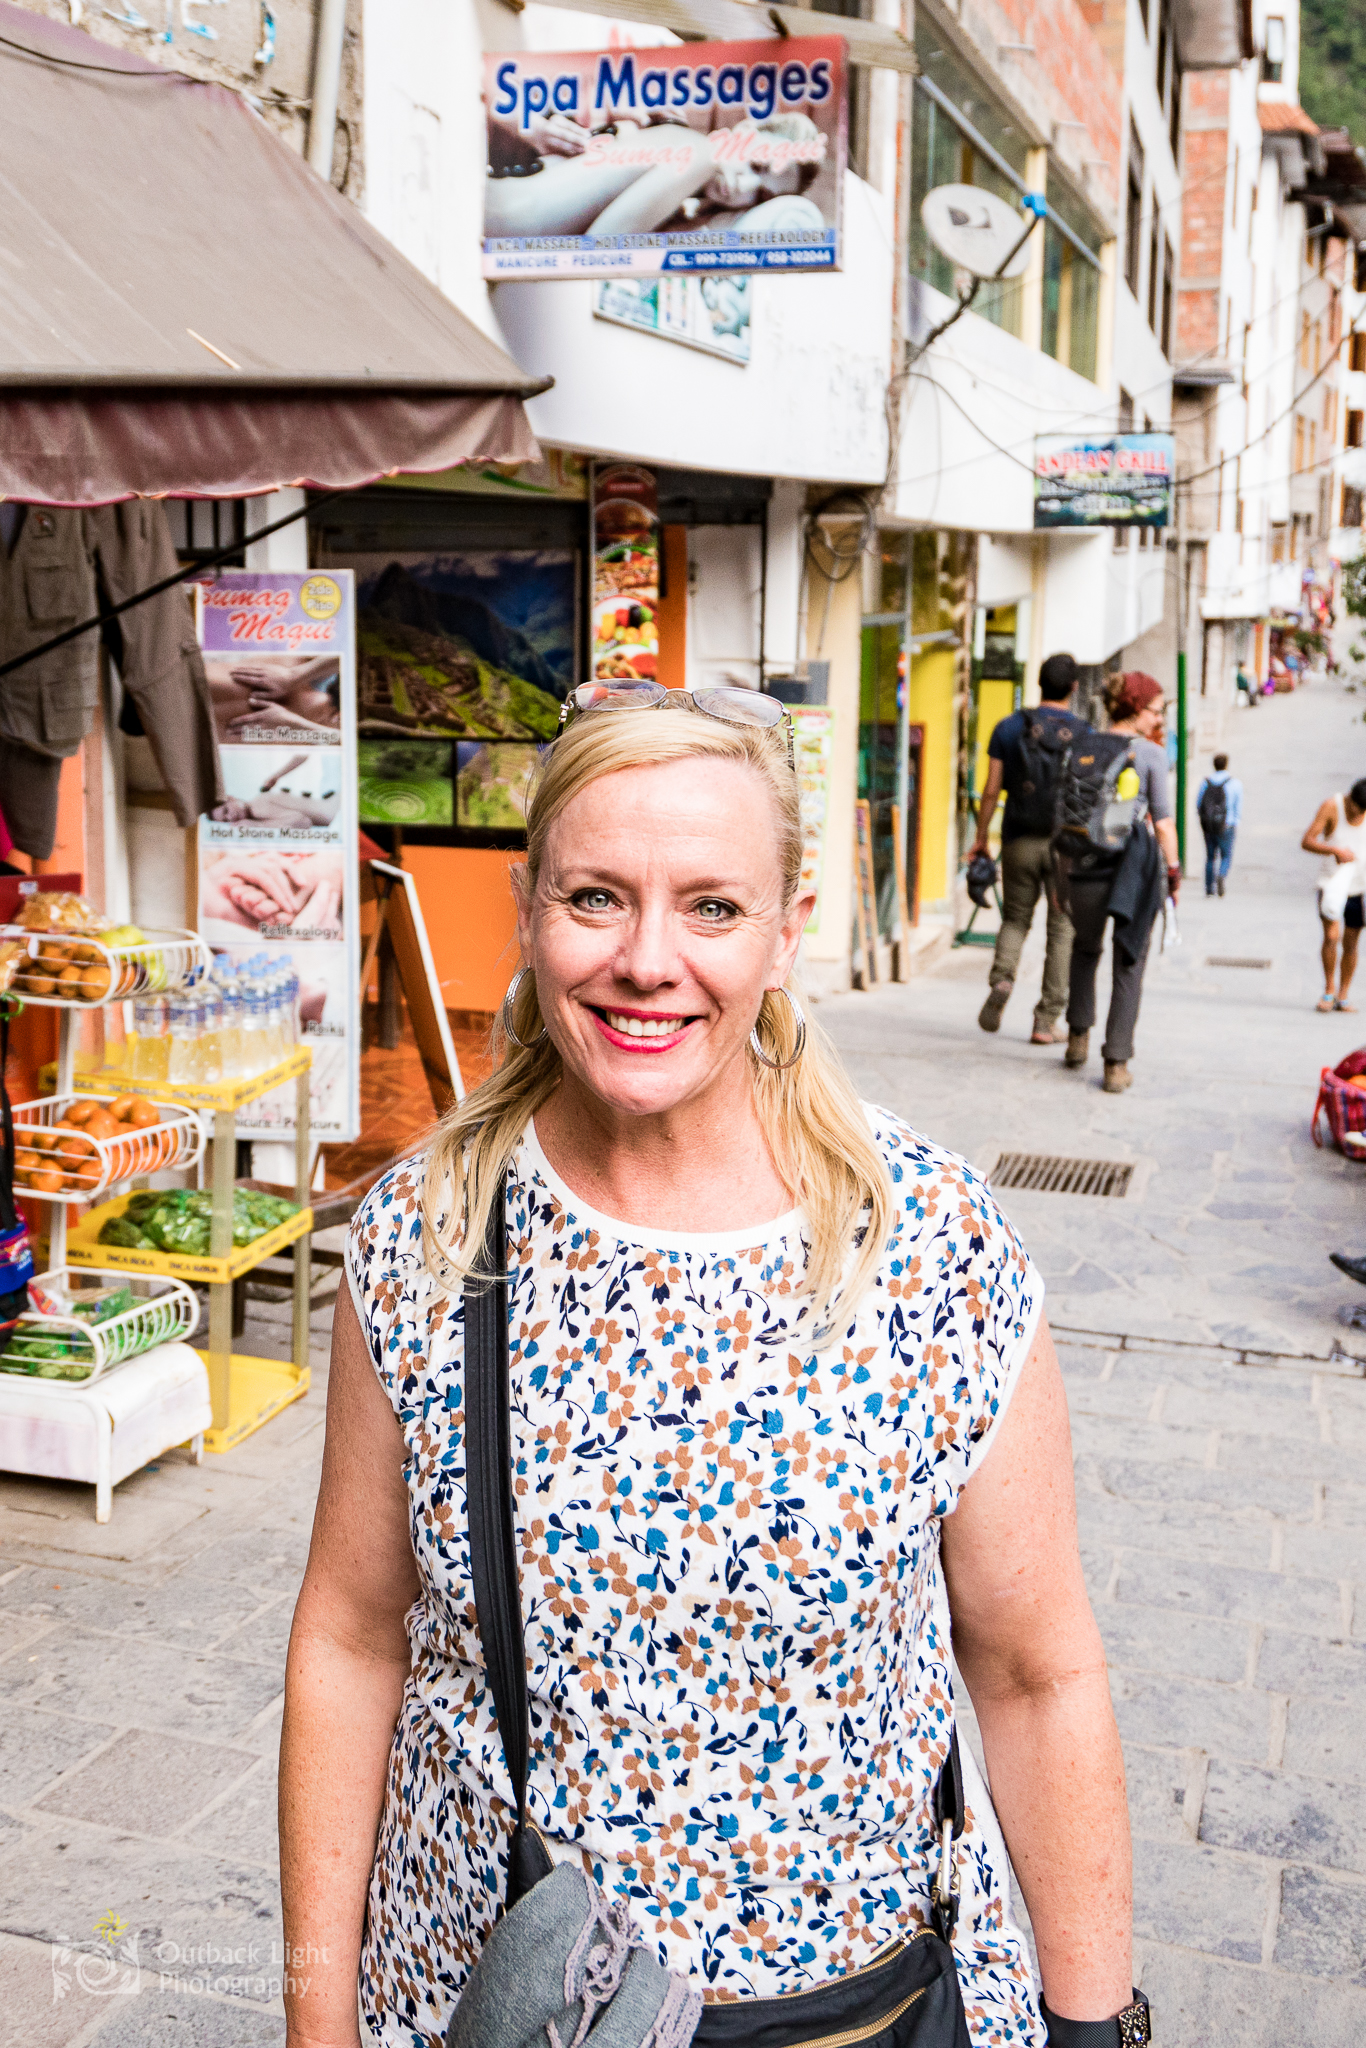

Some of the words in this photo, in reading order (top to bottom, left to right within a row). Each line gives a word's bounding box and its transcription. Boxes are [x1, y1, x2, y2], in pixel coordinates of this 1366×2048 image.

[495, 61, 580, 130] Spa
[595, 55, 832, 119] Massages
[583, 132, 694, 171] Sumaq
[708, 129, 827, 174] Maqui
[491, 238, 520, 252] INCA
[524, 237, 581, 251] MASSAGE
[623, 234, 662, 248] STONE
[667, 232, 726, 246] MASSAGE
[495, 255, 558, 269] MANICURE
[572, 253, 633, 267] PEDICURE
[1037, 451, 1112, 473] ANDEAN
[1116, 450, 1168, 473] GRILL
[227, 611, 336, 650] Maqui
[277, 725, 342, 746] Massage
[210, 825, 234, 840] Hot
[238, 826, 275, 841] Stone
[278, 827, 341, 844] Massage
